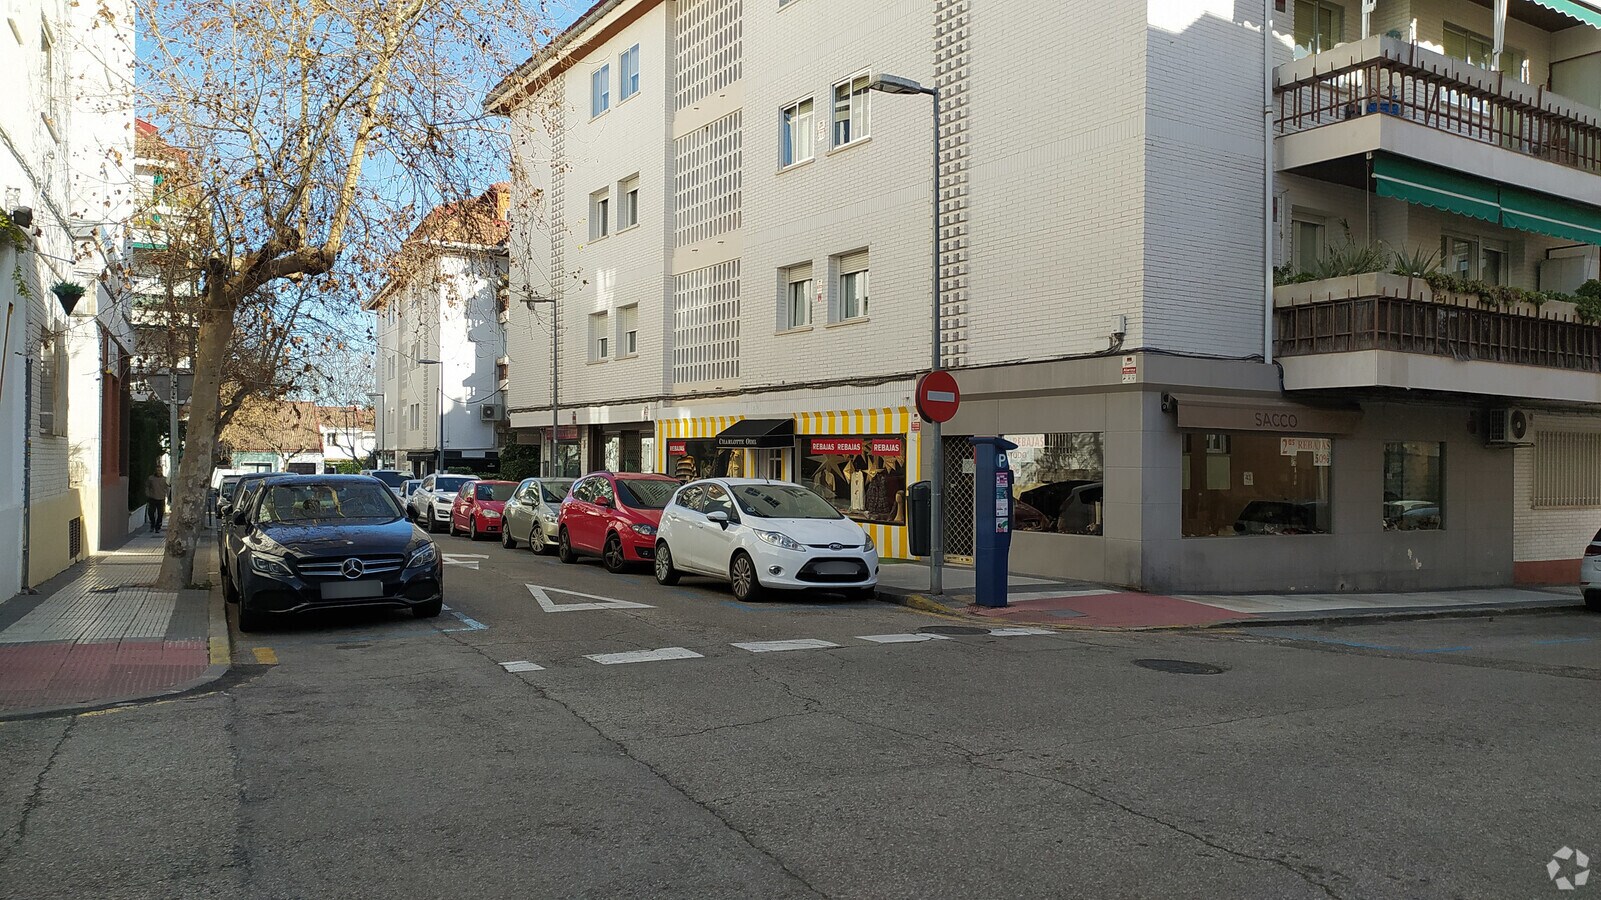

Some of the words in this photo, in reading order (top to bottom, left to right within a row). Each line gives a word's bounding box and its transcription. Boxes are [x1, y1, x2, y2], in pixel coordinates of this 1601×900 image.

[1254, 412, 1298, 428] SACCO
[812, 443, 835, 451] REBAJAS
[837, 443, 861, 451] REBAJAS
[873, 444, 900, 452] REBAJAS
[1297, 440, 1330, 450] REBAJAS
[998, 453, 1006, 467] P
